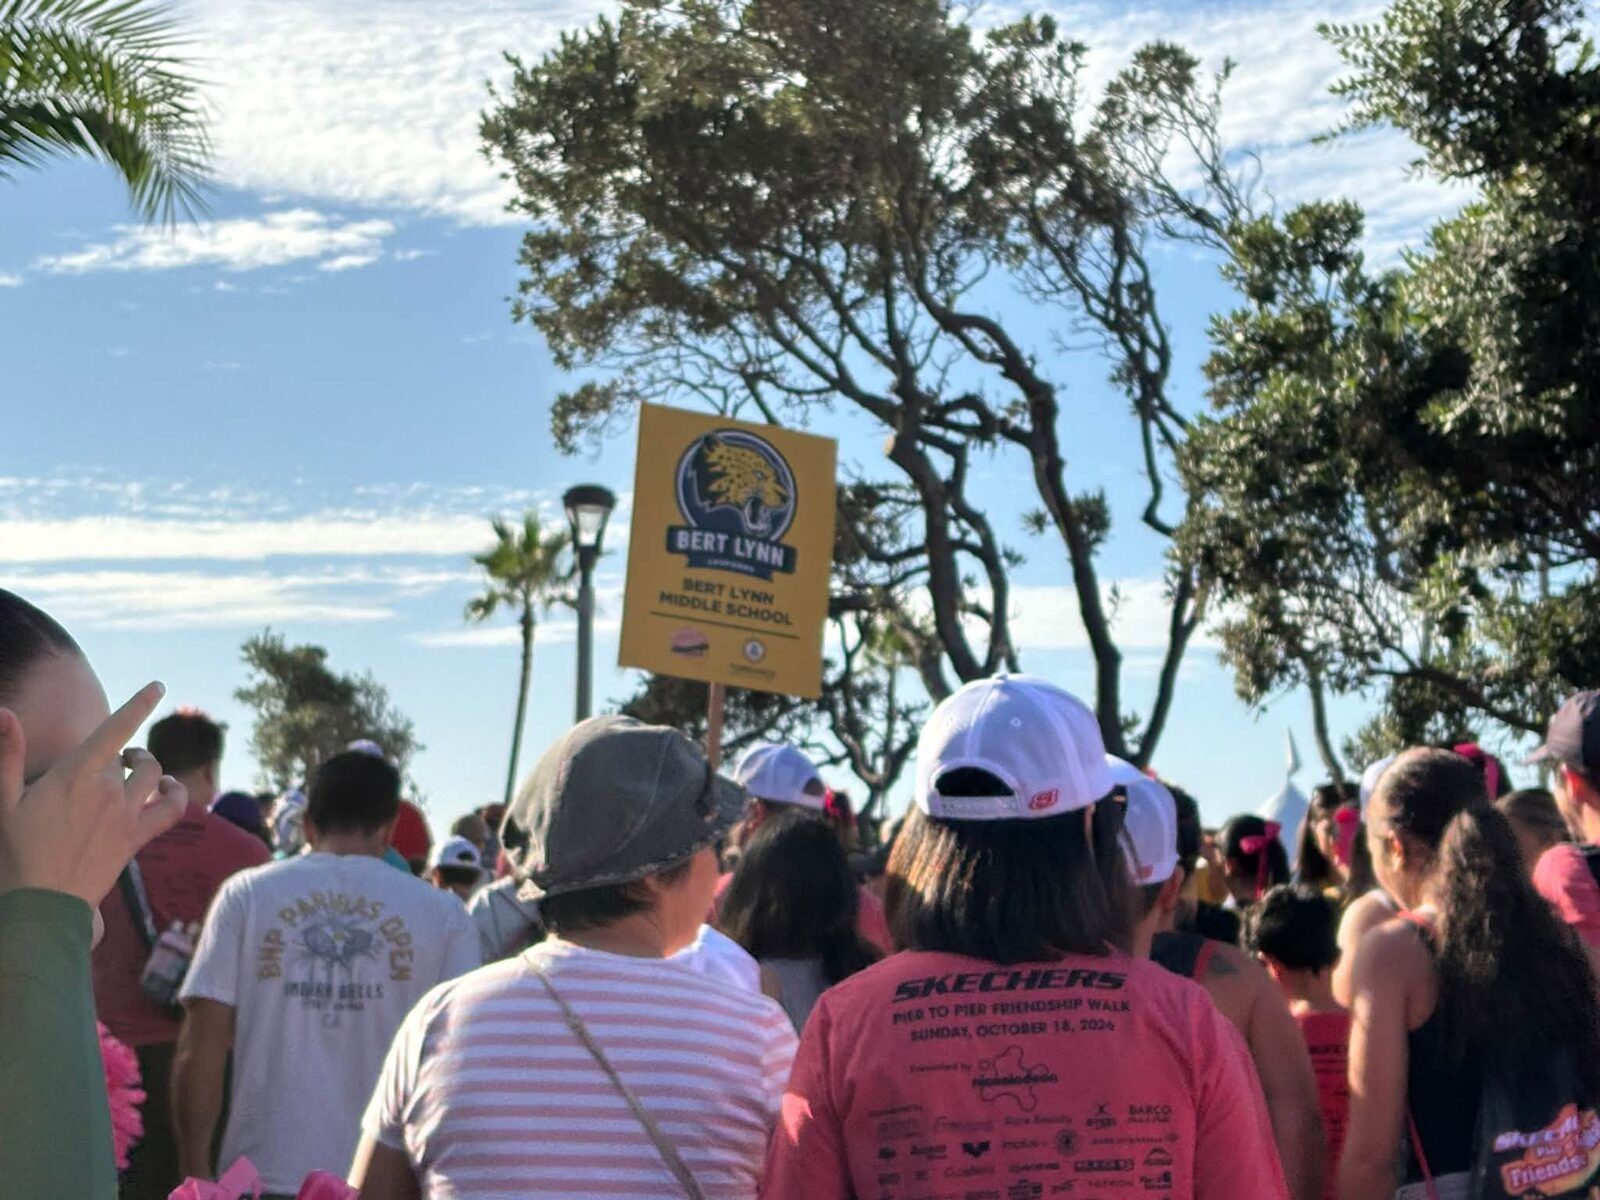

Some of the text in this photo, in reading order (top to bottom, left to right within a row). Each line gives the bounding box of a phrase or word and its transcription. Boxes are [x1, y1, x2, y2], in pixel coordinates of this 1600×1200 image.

[677, 530, 728, 552] BERT
[734, 537, 783, 566] LYNN
[683, 578, 775, 606] BERT LYNN
[659, 591, 794, 625] MIDDLE SCHOOL
[894, 970, 1126, 1002] SKECHERS
[893, 998, 1131, 1025] PIER TO PIER FRIENDSHIP WALK
[911, 1025, 972, 1042] SUNDAY,
[976, 1021, 1046, 1037] OCTOBER
